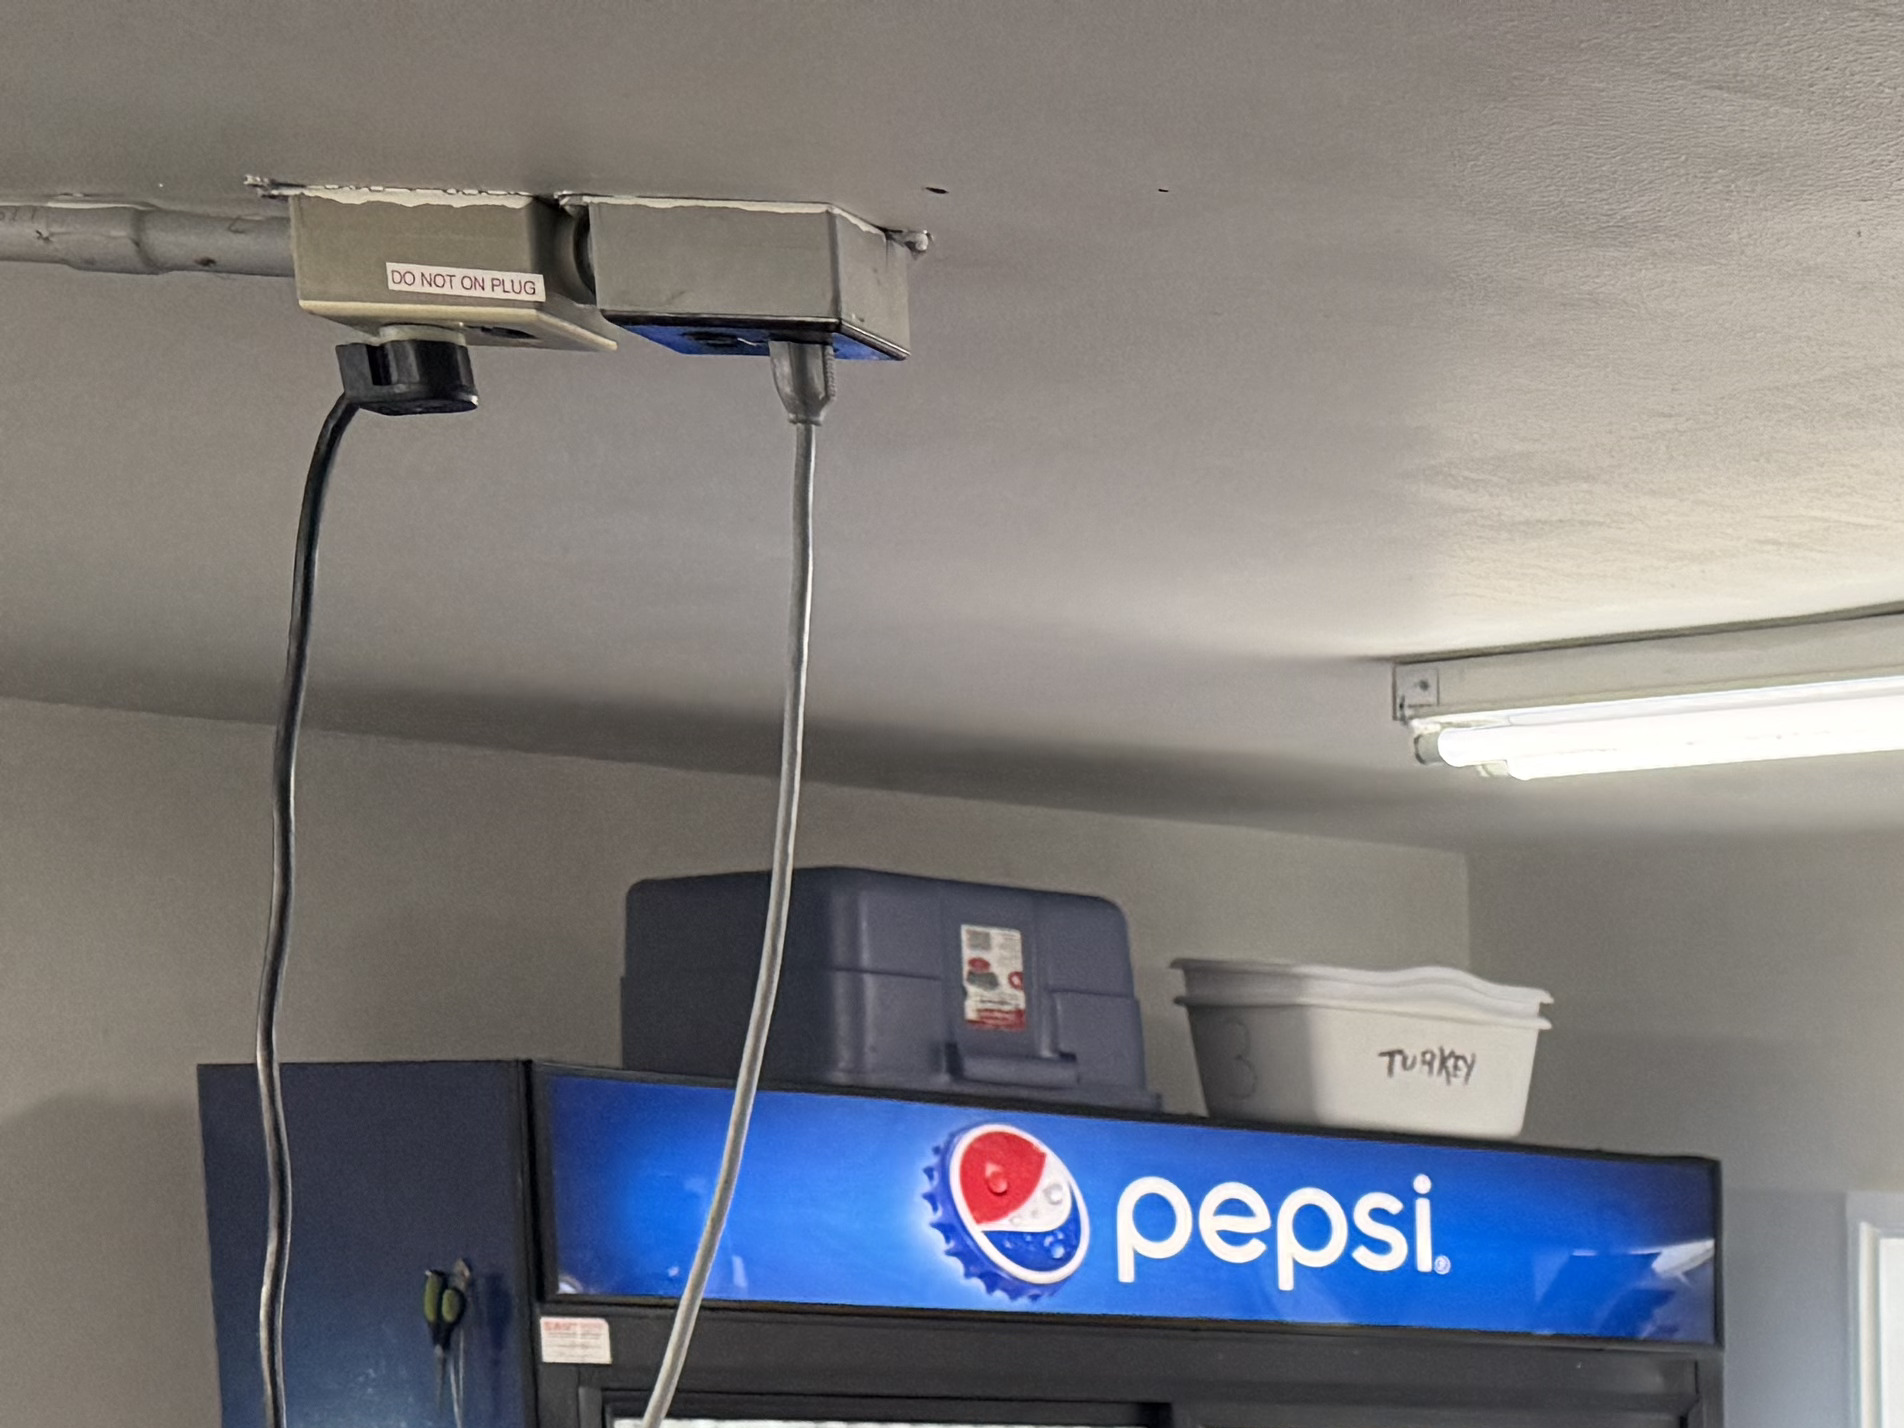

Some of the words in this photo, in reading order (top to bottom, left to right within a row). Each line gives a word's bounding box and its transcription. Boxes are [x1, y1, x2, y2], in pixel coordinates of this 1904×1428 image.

[391, 270, 416, 286] DO
[420, 272, 456, 290] NOT
[461, 275, 485, 292] ON
[491, 278, 536, 295] PLUG
[1378, 1046, 1476, 1086] TURKEY
[1117, 1174, 1433, 1291] pepsi
